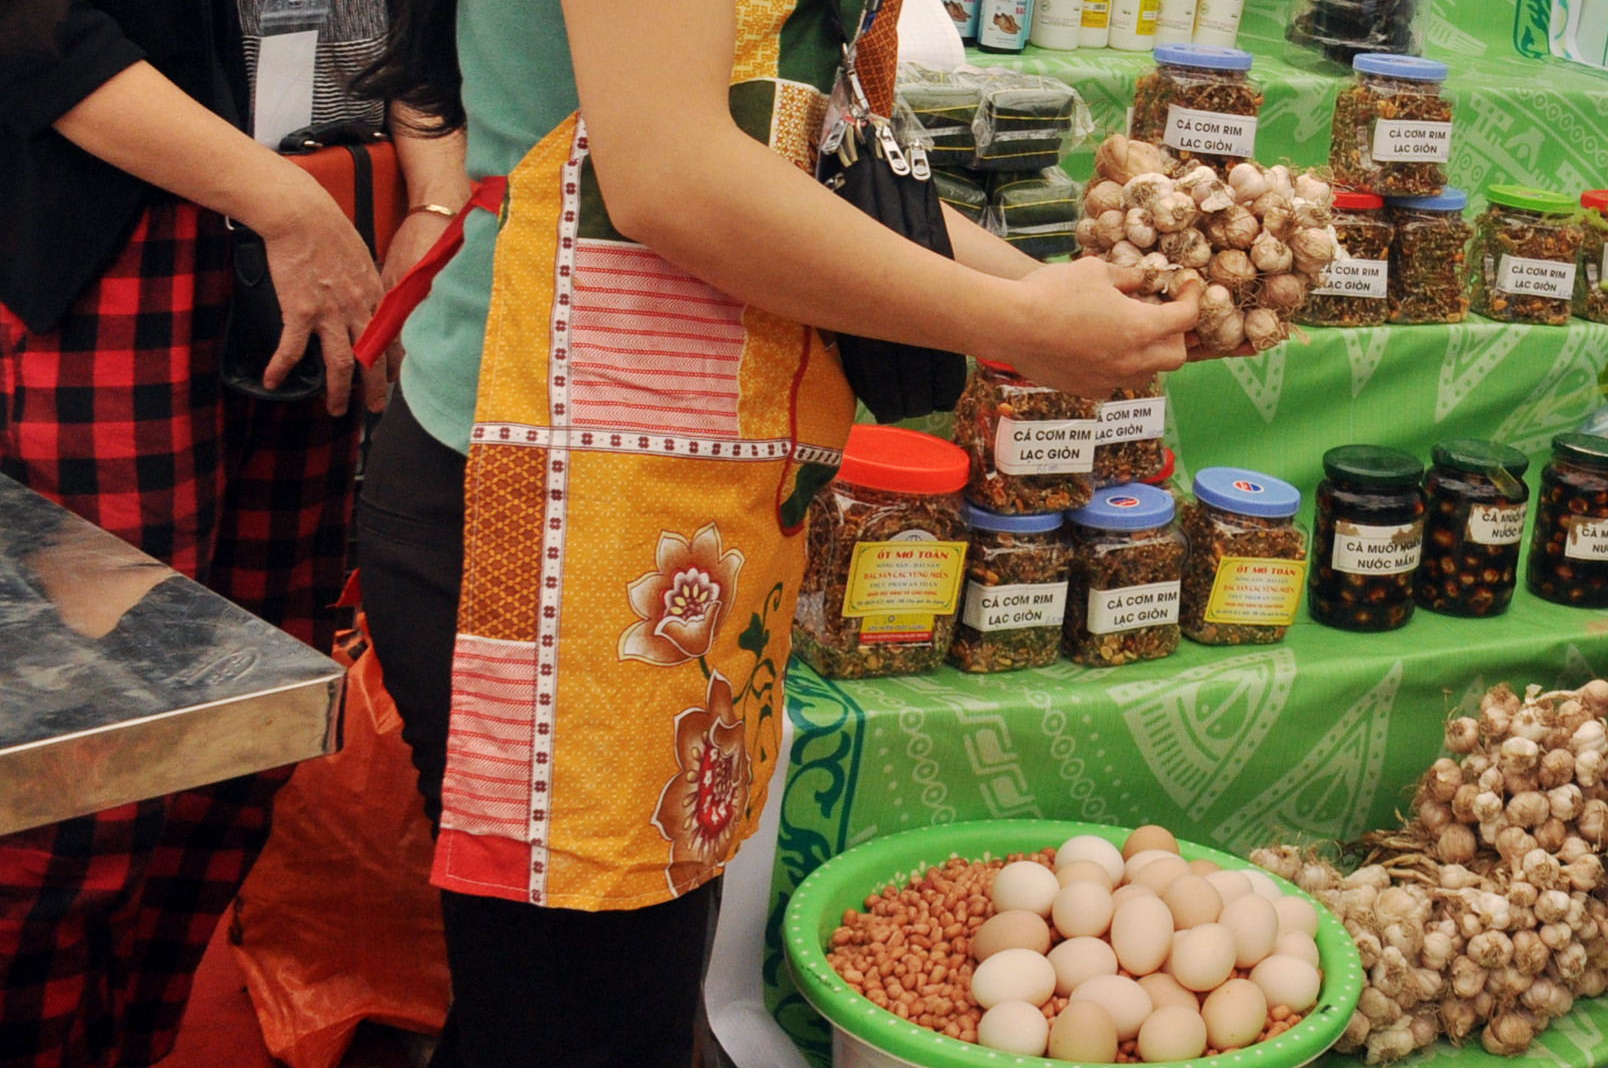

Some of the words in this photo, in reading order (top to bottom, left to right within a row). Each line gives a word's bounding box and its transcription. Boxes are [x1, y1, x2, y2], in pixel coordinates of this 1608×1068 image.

[1194, 121, 1220, 135] CƠM
[1223, 125, 1243, 137] RIM
[1204, 136, 1233, 153] GIÒN
[1014, 429, 1032, 442] CÁ
[1036, 428, 1066, 442] CƠM
[1069, 429, 1091, 440] RIM
[1020, 449, 1043, 463] LẠC
[1047, 445, 1080, 460] GIÒN
[1346, 540, 1364, 553] CÀ
[1358, 555, 1392, 570] NƯỚC
[982, 594, 999, 609] CÁ
[1003, 593, 1030, 607] CƠM
[1033, 594, 1054, 604] RIM
[1107, 596, 1123, 610] CÁ
[1126, 592, 1154, 607] CƠM
[1157, 592, 1178, 603] RIM
[988, 613, 1009, 627] LẠC
[1013, 608, 1042, 622] GIÒN
[1114, 613, 1135, 627] LẠC
[1137, 606, 1169, 620] GIÒN
